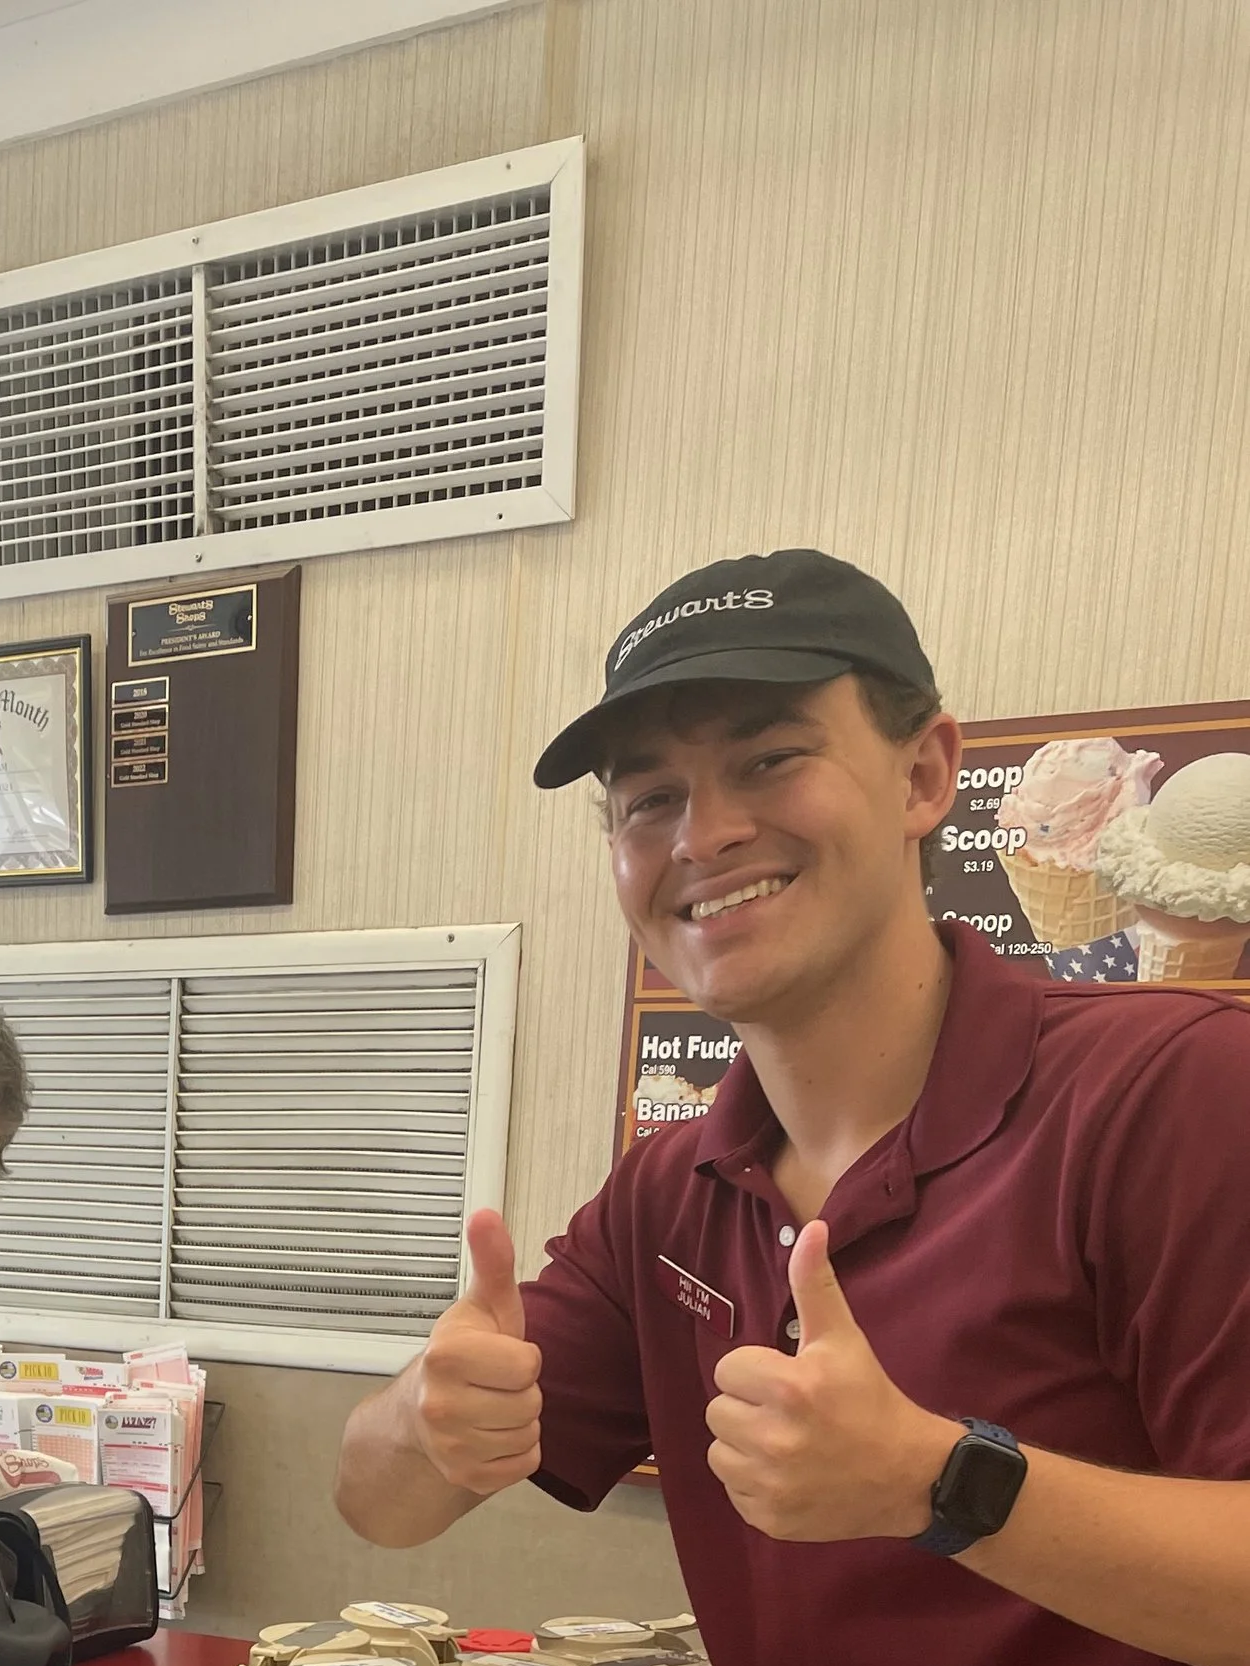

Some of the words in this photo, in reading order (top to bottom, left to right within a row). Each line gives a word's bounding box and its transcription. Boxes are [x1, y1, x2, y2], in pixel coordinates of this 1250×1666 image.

[970, 799, 1000, 811] $2.69
[941, 824, 1027, 856] Scoop
[963, 860, 994, 873] $3.19
[942, 910, 1013, 938] oop
[1008, 943, 1053, 955] 120-250
[641, 1035, 681, 1059] Hot
[641, 1064, 657, 1075] Cal
[658, 1064, 676, 1075] 590
[696, 1287, 709, 1304] I'M
[677, 1291, 711, 1321] JULIAN
[24, 1364, 44, 1377] PICK
[59, 1409, 77, 1423] PICK
